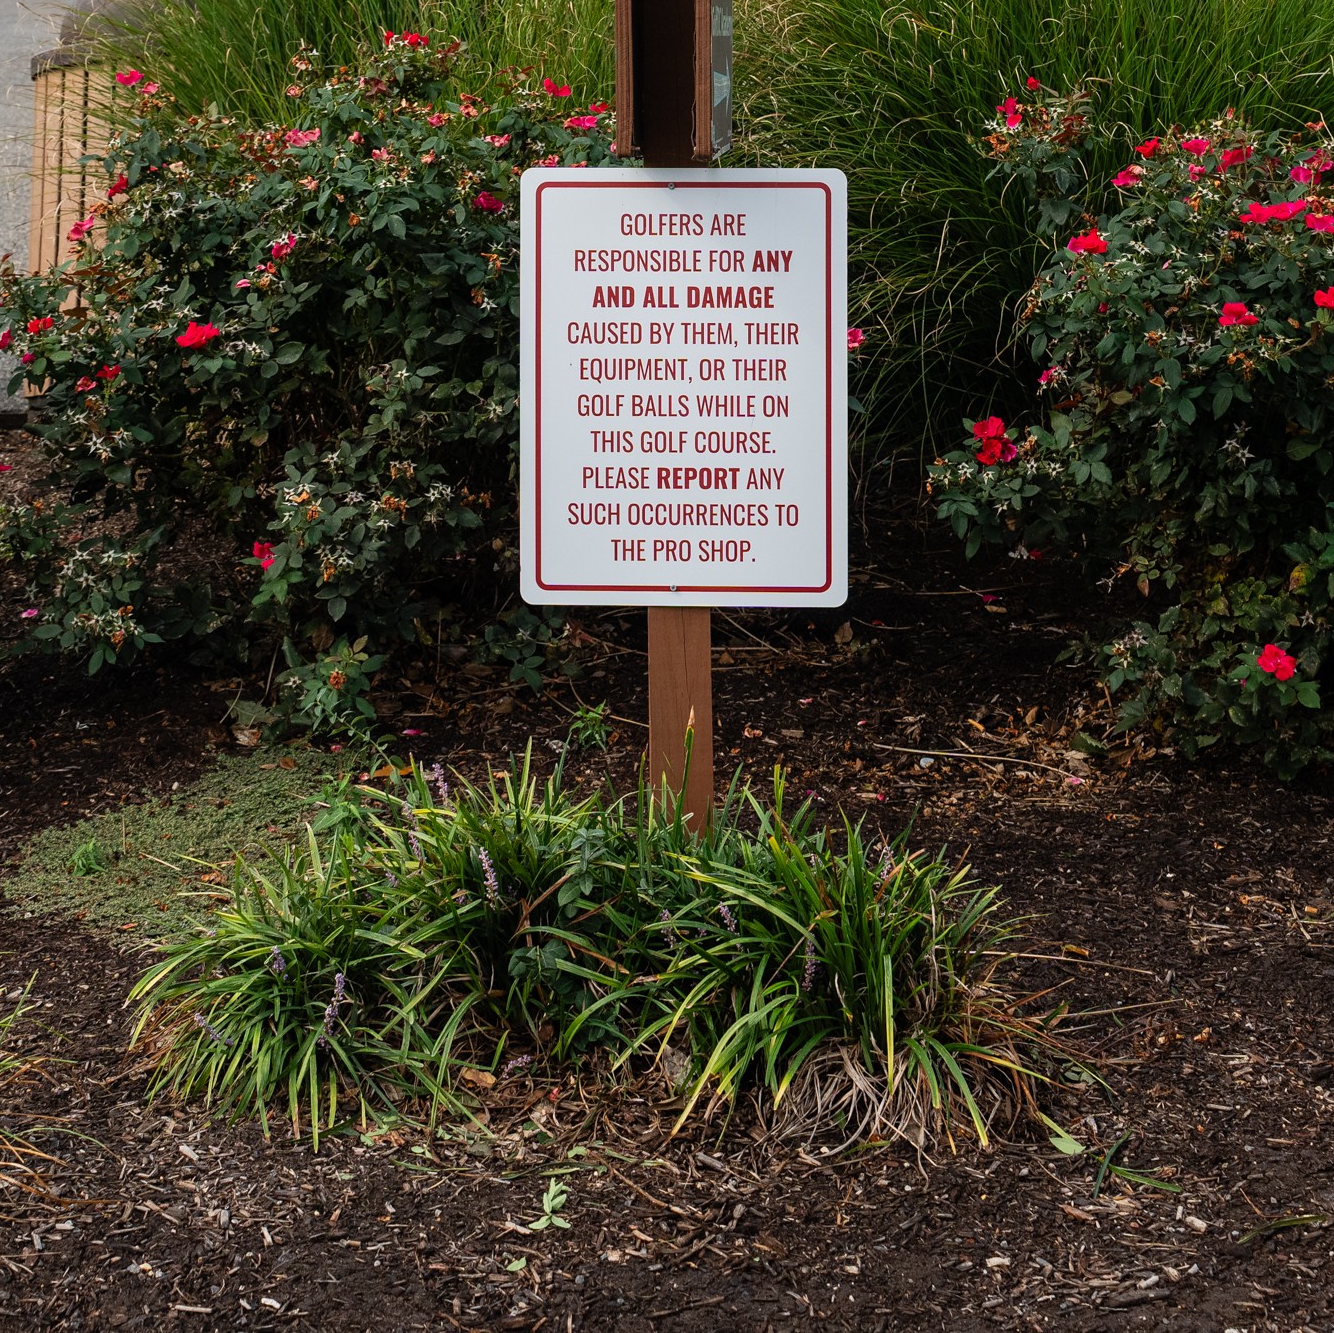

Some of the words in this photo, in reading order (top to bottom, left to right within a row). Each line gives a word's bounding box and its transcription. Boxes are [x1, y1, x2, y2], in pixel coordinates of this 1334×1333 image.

[621, 214, 703, 236] GOLFERS
[709, 214, 747, 236] ARE
[575, 250, 701, 272] RESPONSIBLE
[709, 250, 745, 272] FOR
[751, 250, 793, 272] ANY
[593, 286, 635, 308] AND
[643, 286, 679, 308] ALL
[687, 286, 775, 308] DAMAGE
[567, 322, 643, 344] CAUSED
[649, 322, 675, 344] BY
[681, 322, 737, 348] THEM,
[743, 322, 799, 344] THEIR
[579, 358, 693, 384] EQUIPMENT,
[699, 358, 725, 382] OR
[731, 358, 787, 382] THEIR
[577, 394, 625, 416] GOLF
[631, 394, 689, 418] BALLS
[697, 394, 755, 418] WHILE
[763, 396, 789, 418] ON
[591, 430, 633, 454] THIS
[641, 430, 689, 454] GOLF
[695, 430, 775, 454] COURSE.
[583, 466, 649, 490] PLEASE
[657, 466, 741, 490] REPORT
[747, 468, 785, 490] ANY
[567, 502, 621, 526] SUCH
[627, 504, 769, 526] OCCURRENCES
[775, 504, 799, 526] TO
[611, 540, 647, 562] THE
[653, 540, 691, 562] PRO
[699, 540, 755, 562] SHOP.
